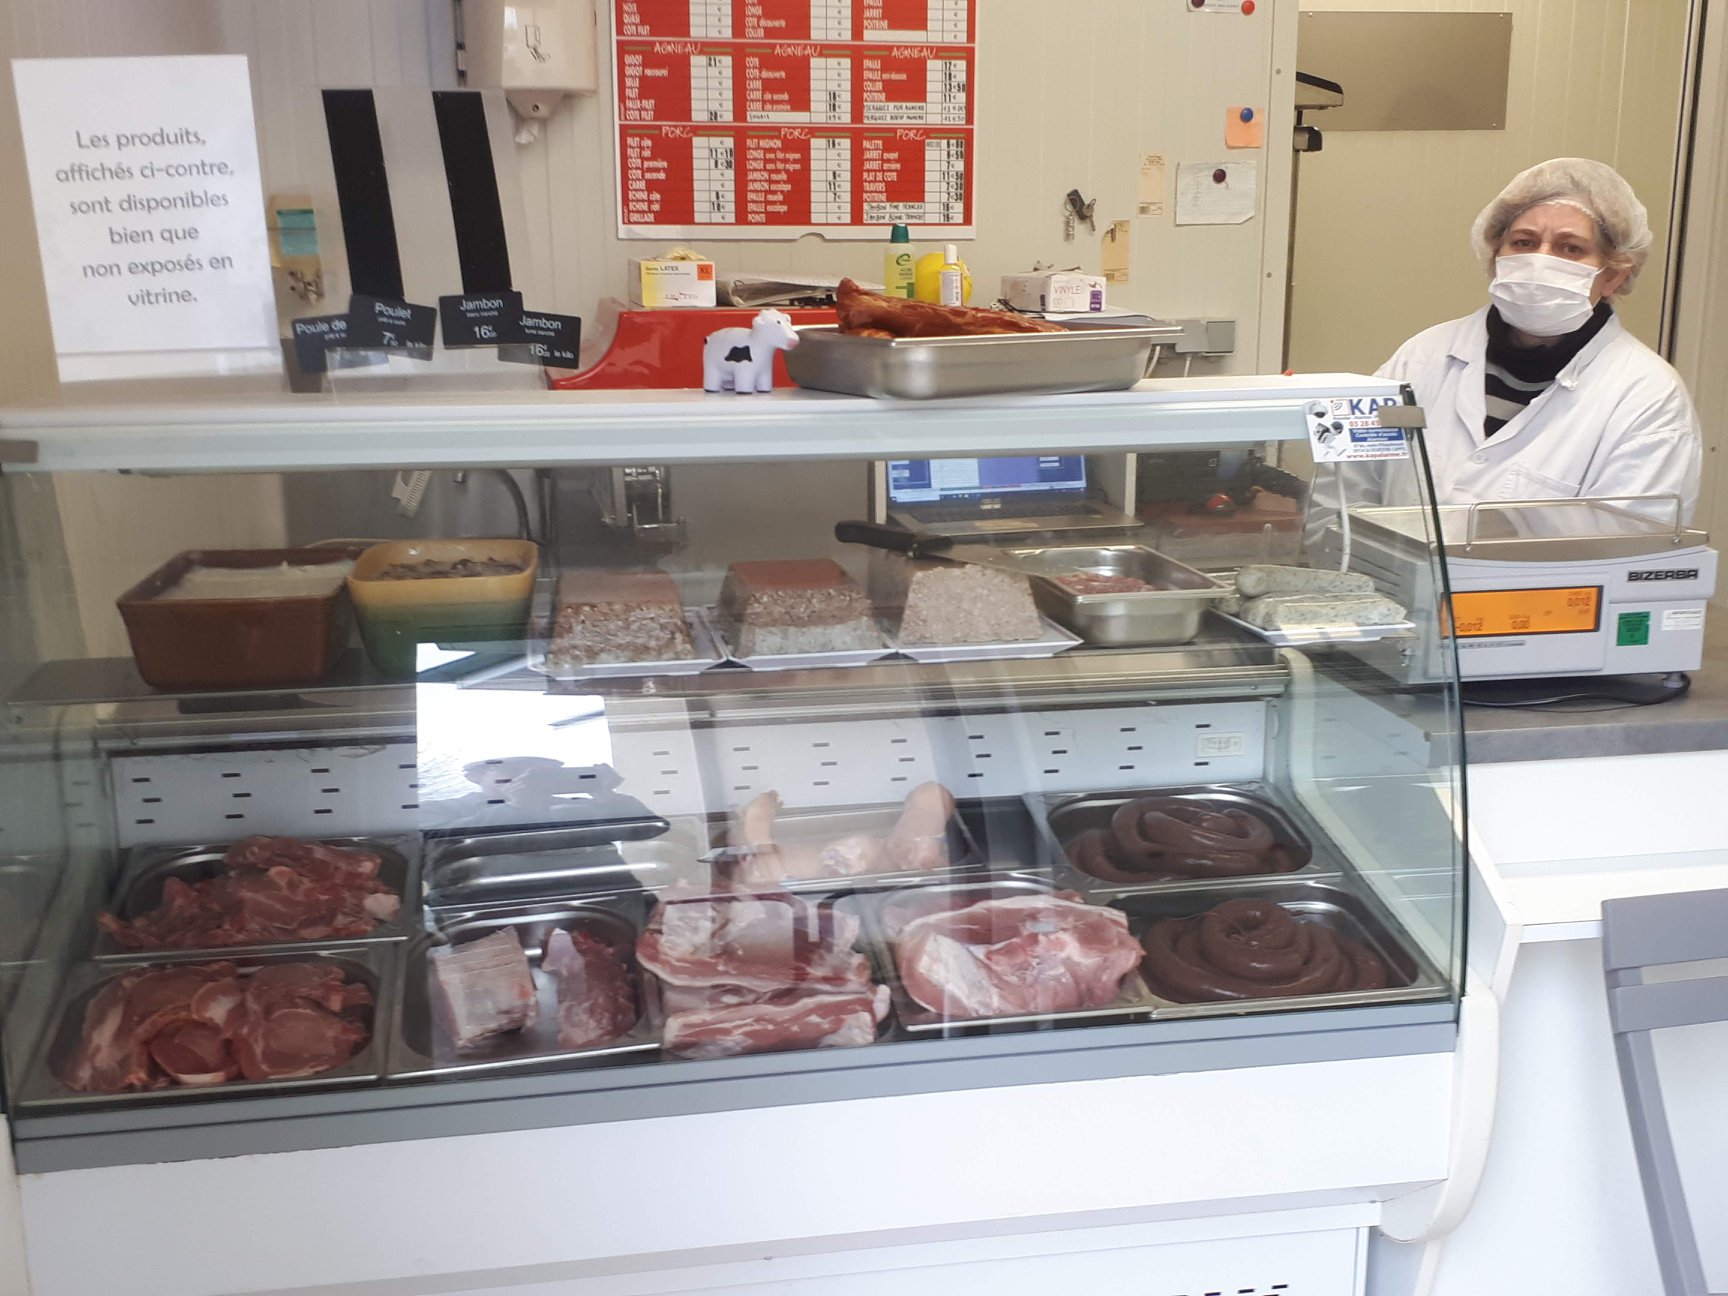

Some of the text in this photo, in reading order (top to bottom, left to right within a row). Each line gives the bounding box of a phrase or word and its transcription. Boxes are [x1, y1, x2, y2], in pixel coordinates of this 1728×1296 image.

[654, 42, 701, 54] AGNEAU
[774, 44, 820, 57] AGNEAU
[892, 46, 937, 59] AGNEAU
[624, 55, 642, 65] GIGOT
[625, 66, 642, 76] GIGOT
[662, 126, 694, 138] PORC
[781, 128, 811, 140] PORC
[896, 129, 926, 141] PORC
[75, 127, 206, 151] Les produits,
[55, 159, 235, 183] affichés ci-contre,
[70, 190, 230, 215] sont disponibles
[109, 226, 200, 245] bien que
[82, 254, 234, 279] non exposés en
[1053, 285, 1081, 295] VINYLE
[127, 288, 199, 307] vitrine.
[375, 302, 412, 320] Poulet
[460, 298, 504, 312] Jambon
[295, 320, 348, 336] Poule de
[519, 315, 562, 330] Jambon
[1627, 569, 1699, 582] BIZERBA
